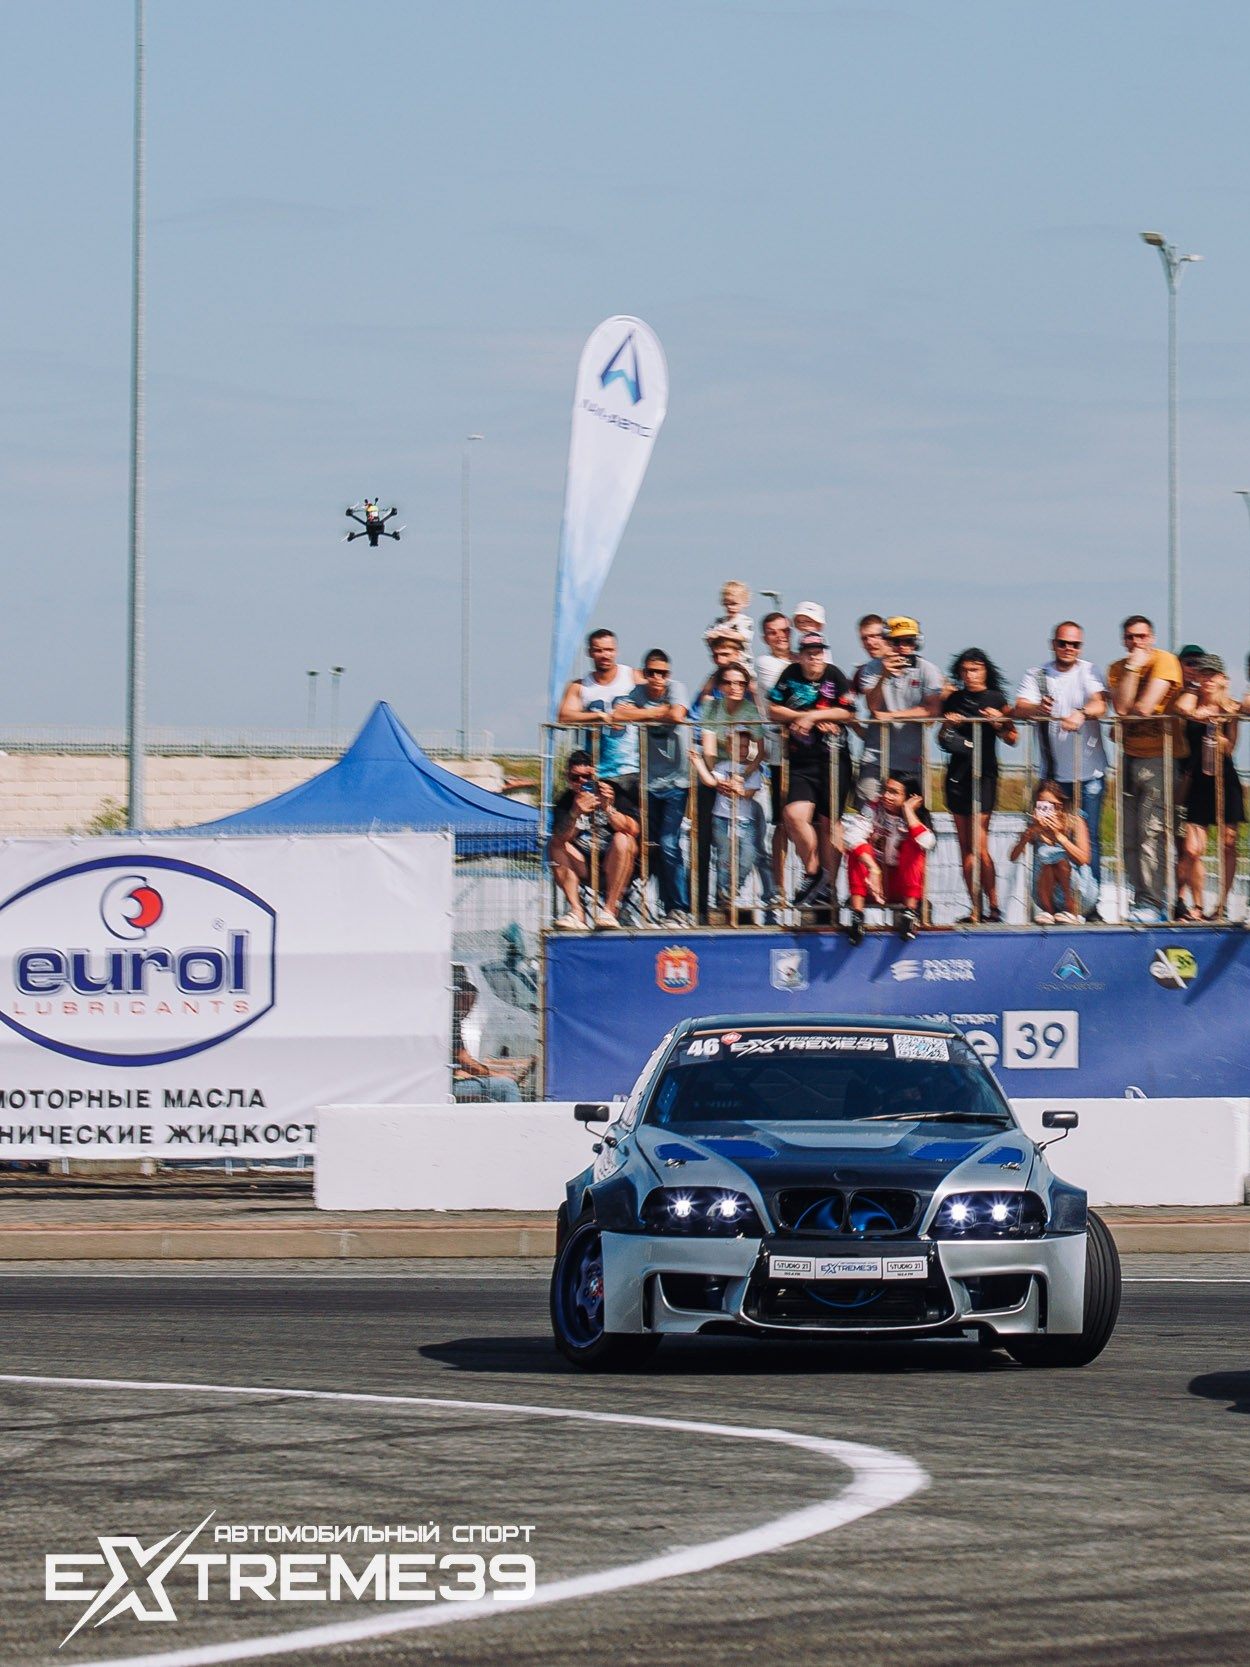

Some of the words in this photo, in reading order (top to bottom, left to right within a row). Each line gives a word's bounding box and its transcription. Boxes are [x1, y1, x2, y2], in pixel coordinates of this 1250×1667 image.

[16, 930, 250, 996] eurol
[13, 1000, 250, 1016] LUBRICANTS
[687, 1037, 720, 1057] 46
[730, 1035, 889, 1058] EXTREME39
[1016, 1022, 1066, 1060] 39
[163, 1088, 266, 1109] МАСЛА
[821, 1261, 878, 1276] EXTREME39
